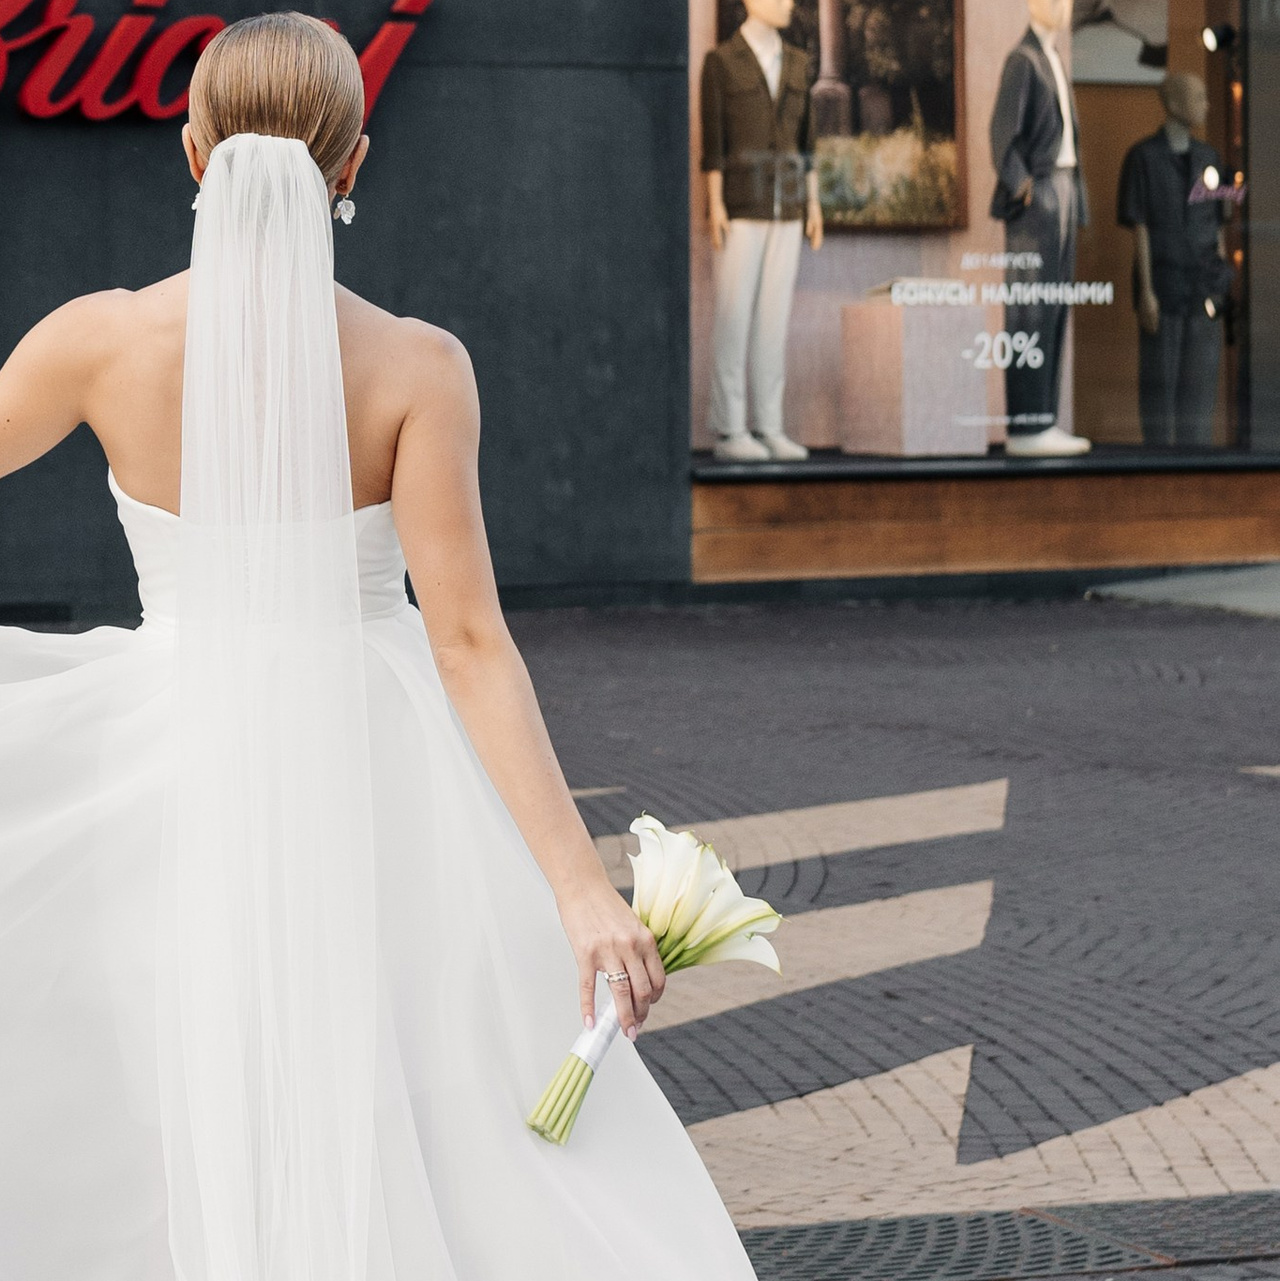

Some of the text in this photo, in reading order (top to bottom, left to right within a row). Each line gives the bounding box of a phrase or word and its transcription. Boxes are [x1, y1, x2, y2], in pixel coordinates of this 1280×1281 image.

[891, 281, 1114, 306] БОНУСЫ НАЛИЧНЫМИ
[961, 330, 1045, 369] -20%
